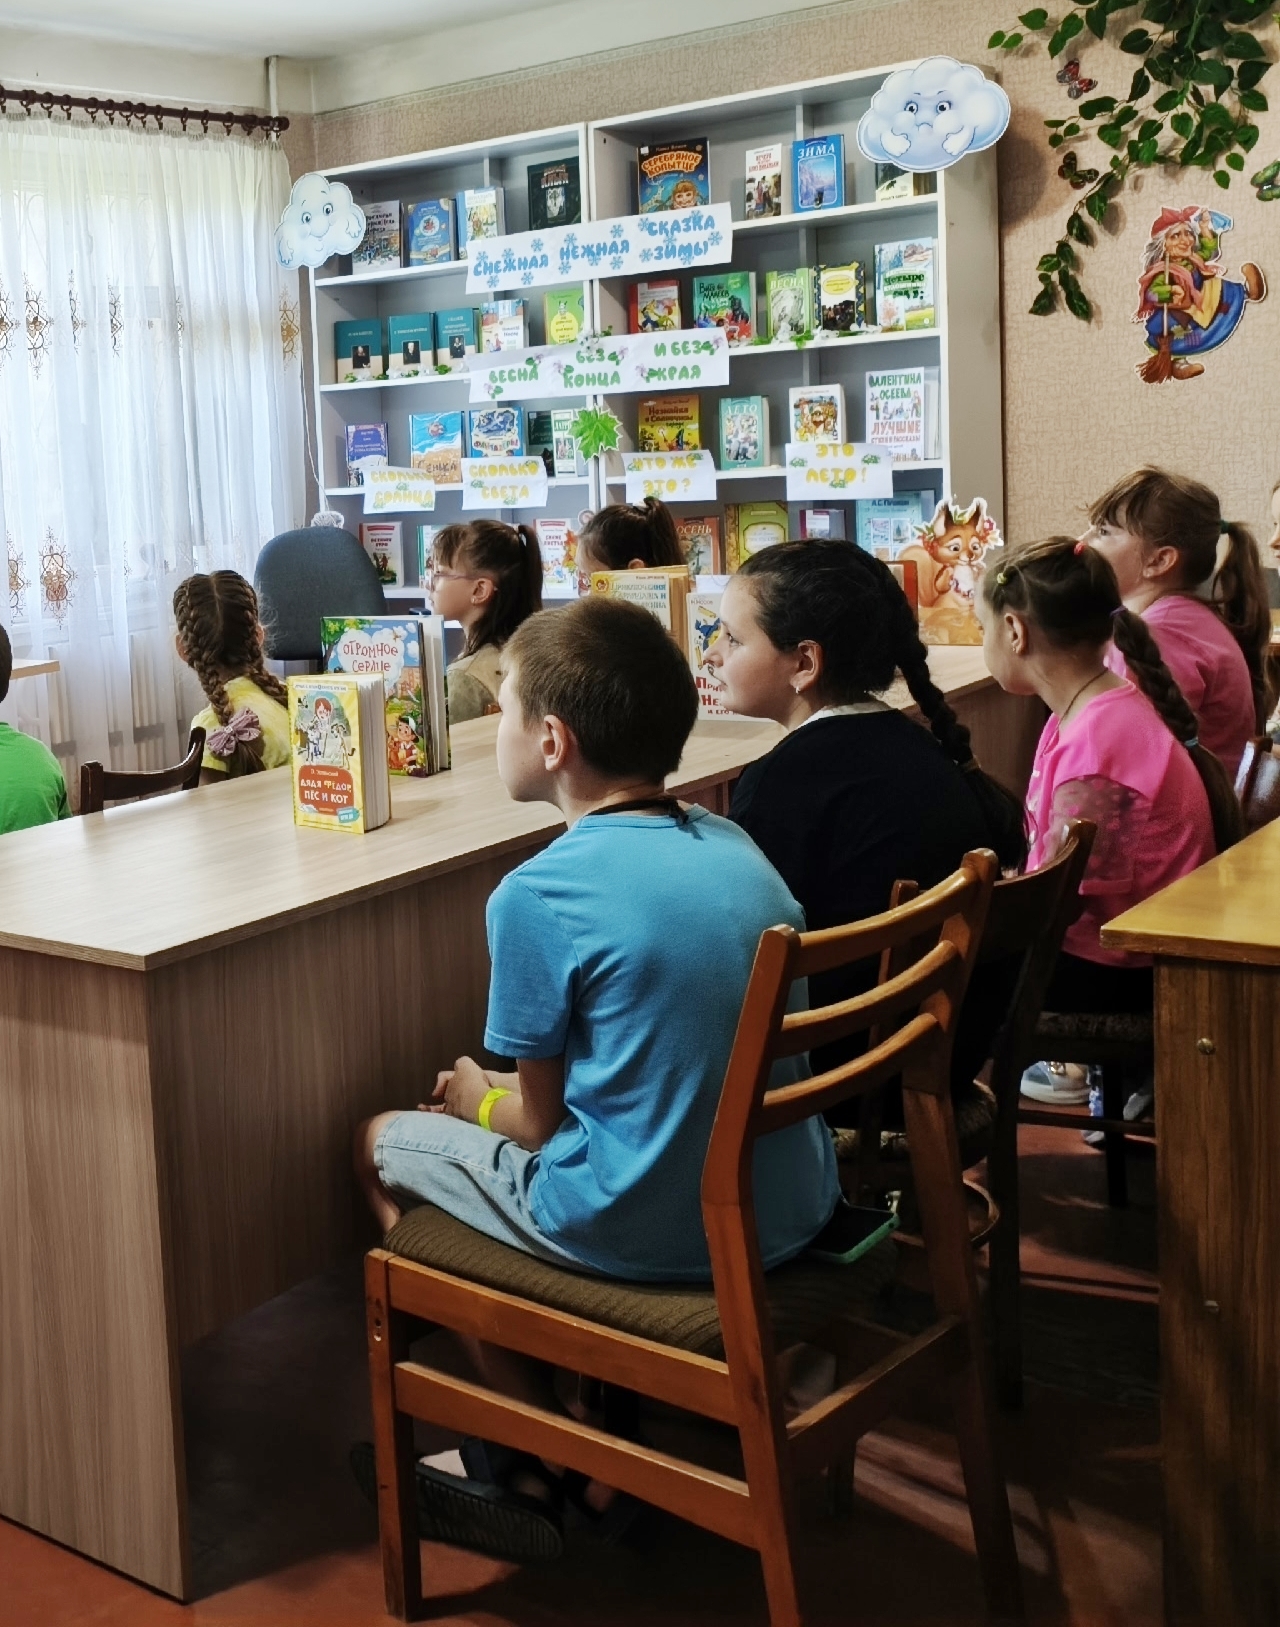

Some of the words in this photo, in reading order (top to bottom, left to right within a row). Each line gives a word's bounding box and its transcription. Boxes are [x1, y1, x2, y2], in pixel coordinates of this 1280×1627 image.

[798, 143, 835, 159] ЗИМА
[642, 152, 701, 171] СЕРЕБРЯНОЕ
[647, 161, 695, 177] КОПЫТЦЕ
[647, 215, 715, 237] СКАЗКА
[473, 253, 549, 276] СНЕЖНАЯ
[559, 239, 630, 261] НЕЖНАЯ
[653, 240, 709, 260] ЗИМЫ
[770, 277, 804, 289] ВЕСНА
[653, 342, 667, 357] И
[670, 340, 703, 356] БЕЗ
[488, 365, 539, 384] ВЕСНА
[563, 370, 621, 389] КОНЦА
[869, 373, 921, 387] ВАЛЕНТИНА
[880, 388, 911, 400] ОСЕЕВА
[726, 404, 758, 414] ЛЕТО
[871, 420, 921, 435] ЛУЧШИЕ
[816, 443, 855, 457] ЭТО
[469, 462, 539, 478] СКОЛЬКО
[481, 485, 529, 499] СВЕТА
[676, 525, 712, 534] ОСЕНЬ
[300, 779, 322, 788] ДЯДЯ
[322, 792, 328, 801] И
[331, 793, 349, 804] КОТ
